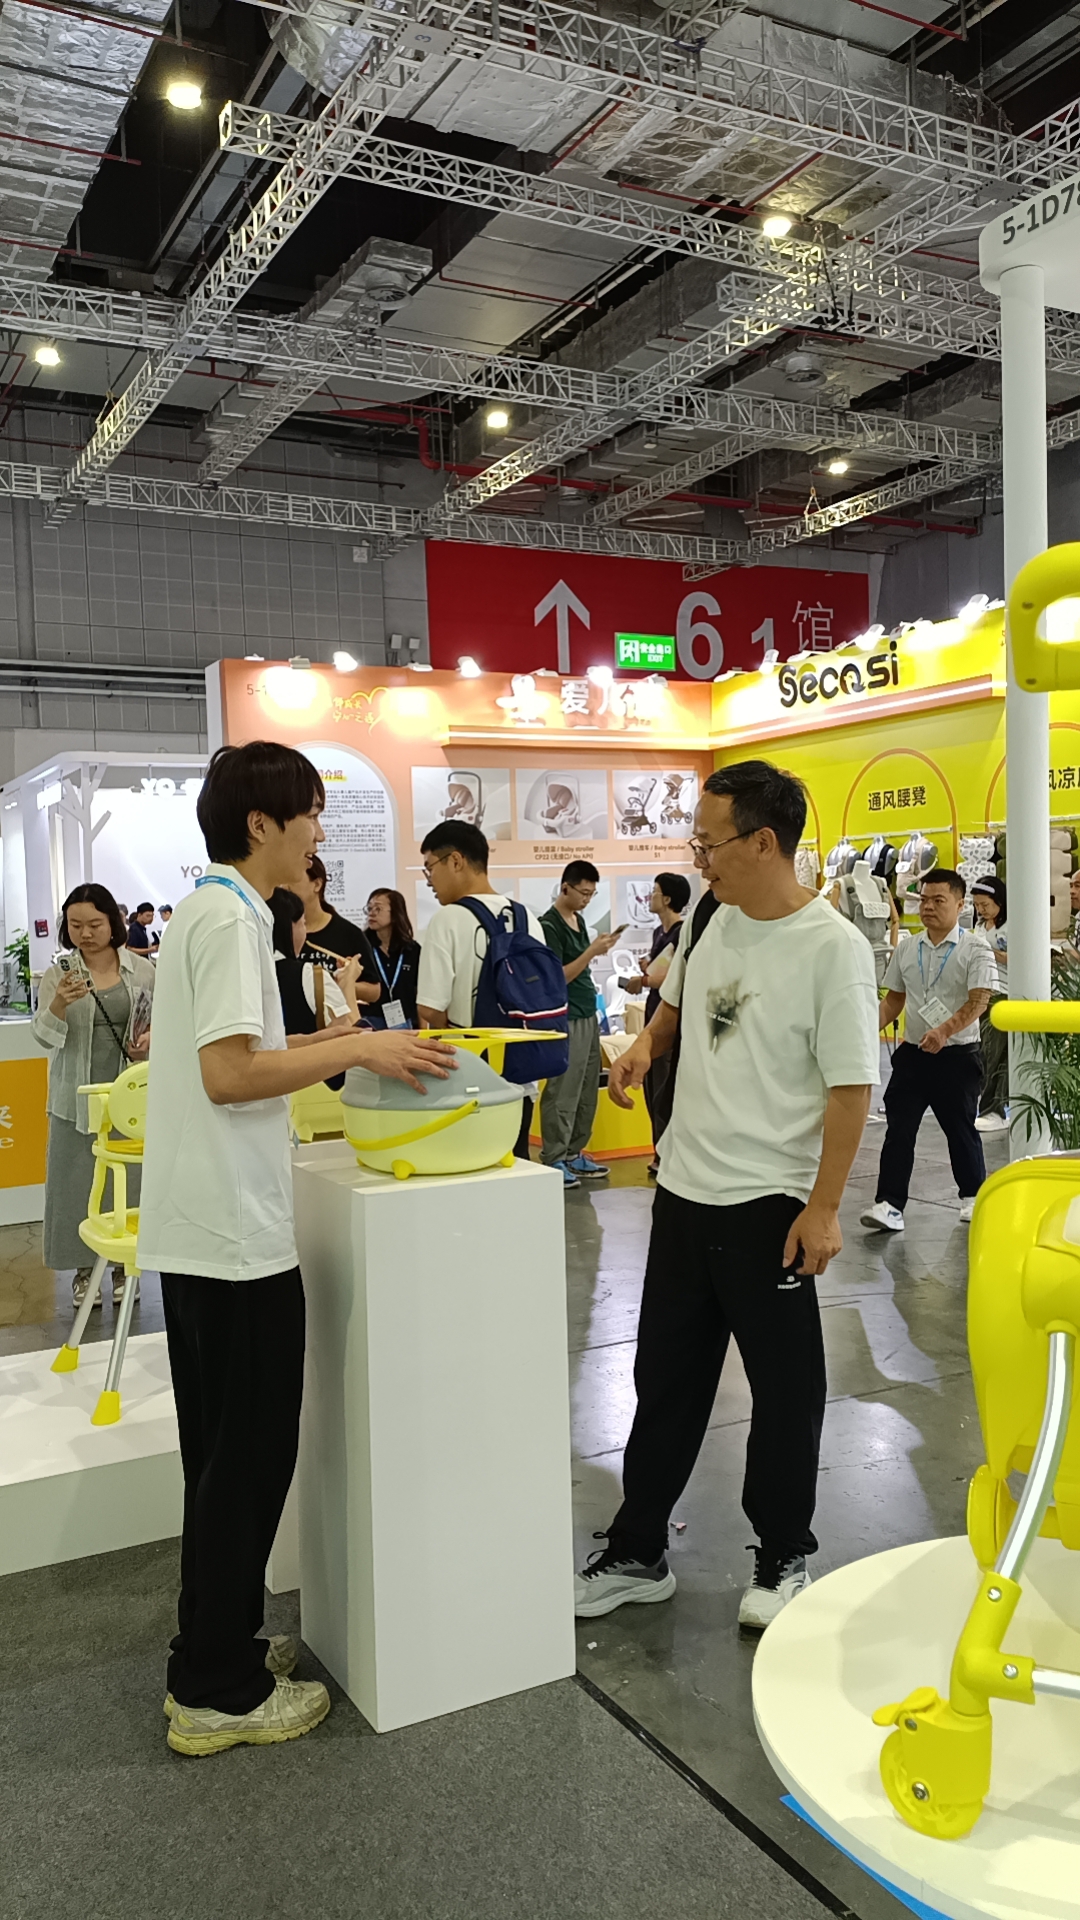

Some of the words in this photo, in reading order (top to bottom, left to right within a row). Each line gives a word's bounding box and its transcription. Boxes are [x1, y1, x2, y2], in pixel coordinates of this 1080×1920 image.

[1003, 180, 1080, 245] 5-1D7
[868, 785, 926, 811] 通风腰凳
